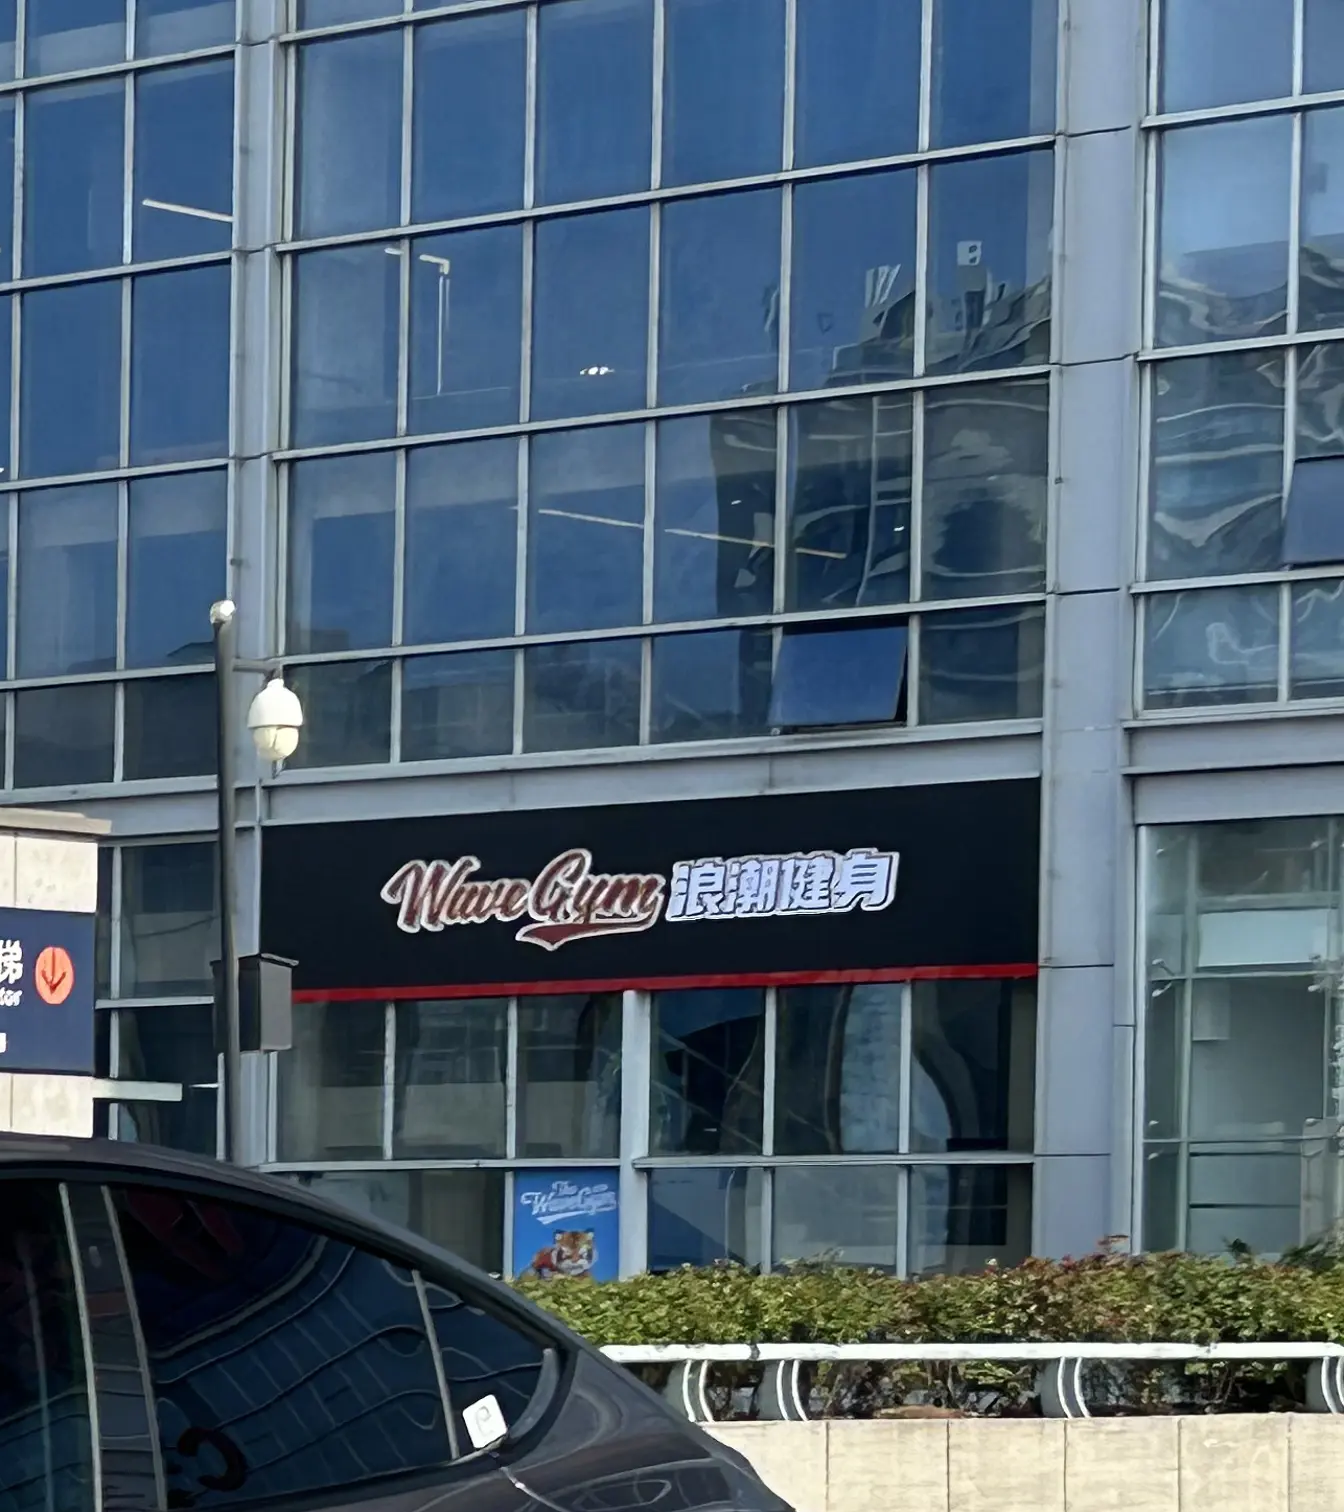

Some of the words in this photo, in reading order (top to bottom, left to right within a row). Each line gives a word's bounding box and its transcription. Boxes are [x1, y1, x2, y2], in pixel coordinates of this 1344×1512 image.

[381, 855, 531, 933] Wave
[527, 848, 666, 940] Gym
[666, 847, 900, 922] 浪潮健身
